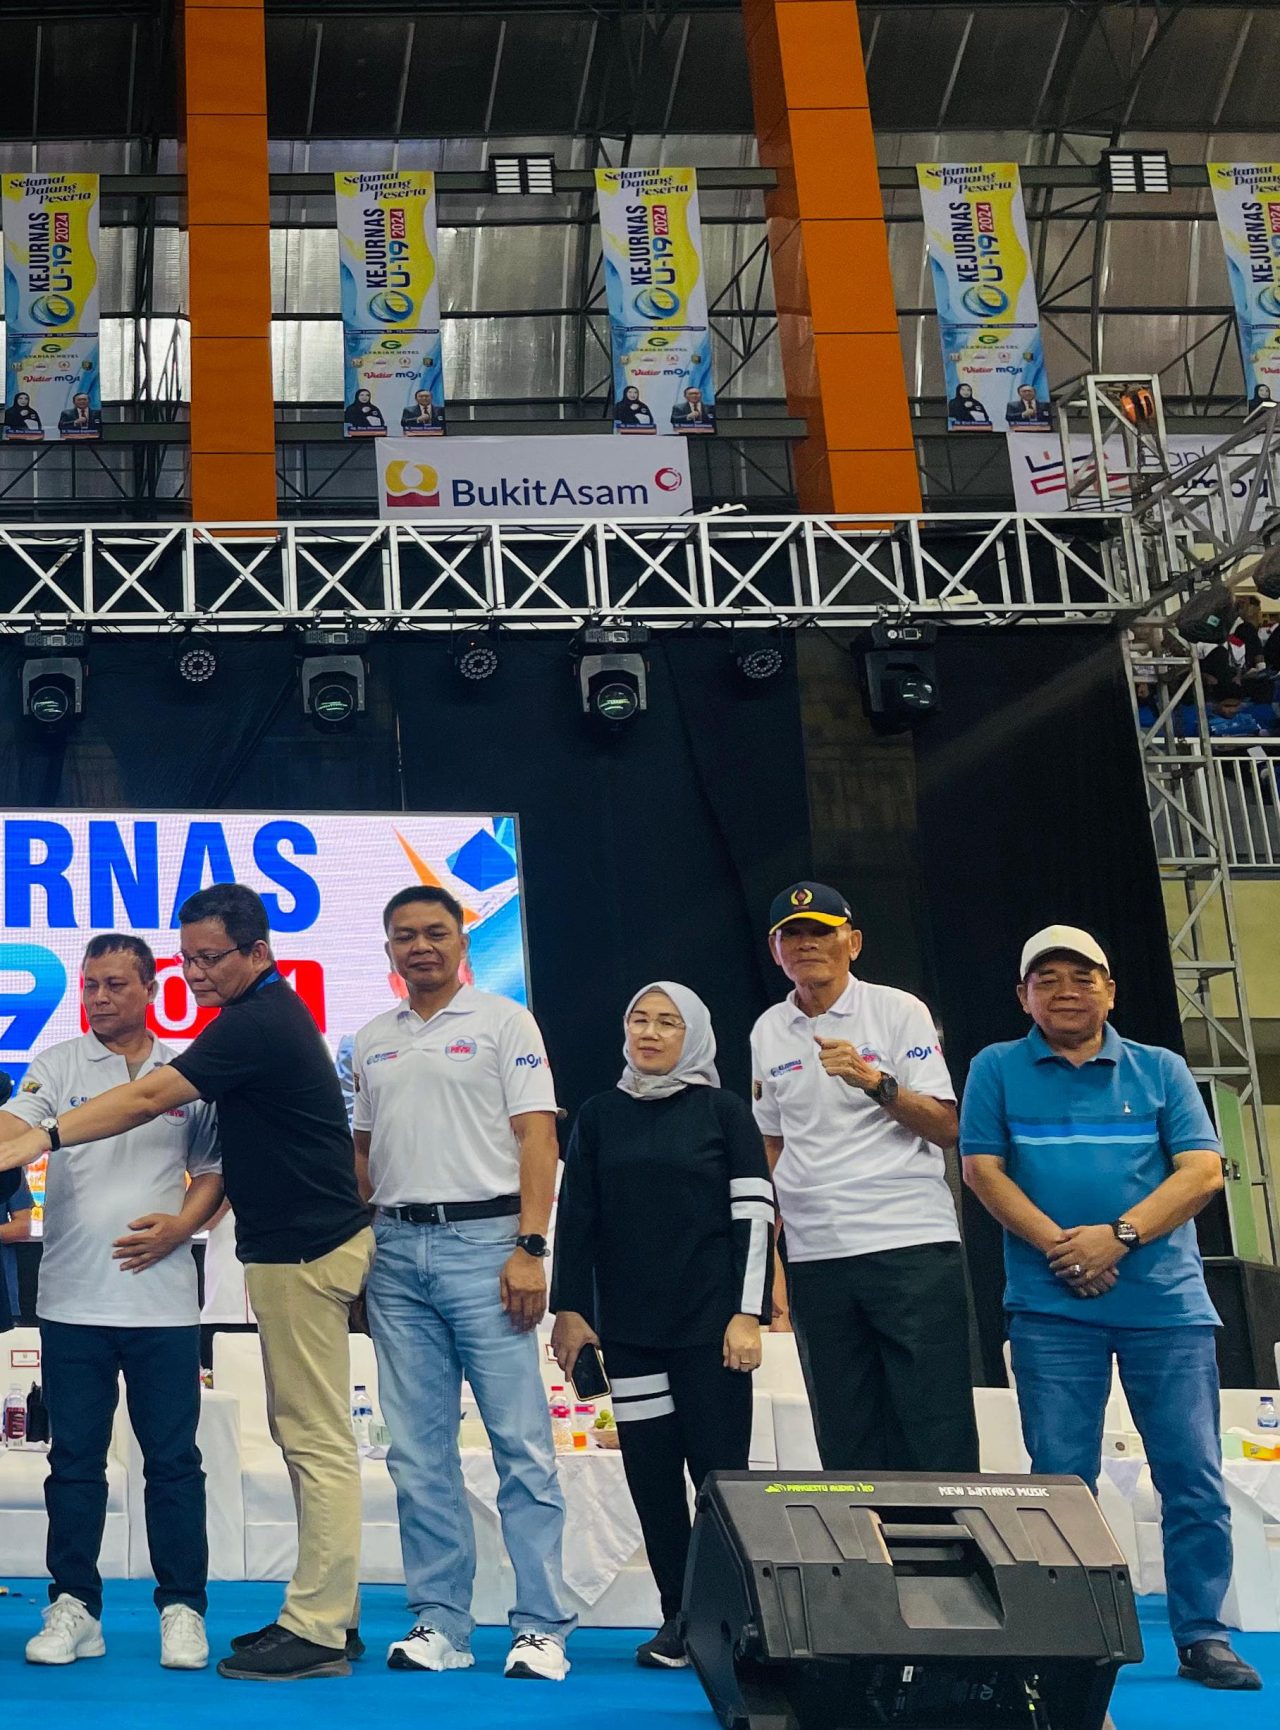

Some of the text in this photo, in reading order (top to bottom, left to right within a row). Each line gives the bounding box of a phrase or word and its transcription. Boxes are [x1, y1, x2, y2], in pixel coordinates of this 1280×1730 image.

[344, 172, 399, 184] Selamat
[604, 168, 660, 181] Selamat
[926, 165, 982, 178] Selamat
[1217, 166, 1272, 177] Selamat
[10, 176, 65, 188] Selamat
[621, 176, 673, 189] Datang
[943, 172, 996, 185] Datang
[25, 183, 77, 196] Datang
[360, 179, 412, 192] Datang
[635, 185, 688, 197] Peserta
[959, 182, 1012, 194] Peserta
[40, 192, 91, 204] Peserta
[374, 189, 427, 200] Peserta
[363, 208, 388, 288] KEJURNAS
[625, 205, 653, 286] KEJURNAS
[652, 207, 676, 285] U-19 2024
[949, 202, 979, 282] KEJURNAS
[978, 204, 1003, 282] U-19 2024
[1242, 202, 1274, 282] KEJURNAS
[28, 212, 50, 292] KEJURNAS
[52, 215, 72, 292] U-19 2024
[389, 210, 411, 288] U-19 2024
[452, 478, 649, 507] BukitAsam
[938, 1486, 964, 1496] NEW
[1016, 1488, 1050, 1497] MUSIC
